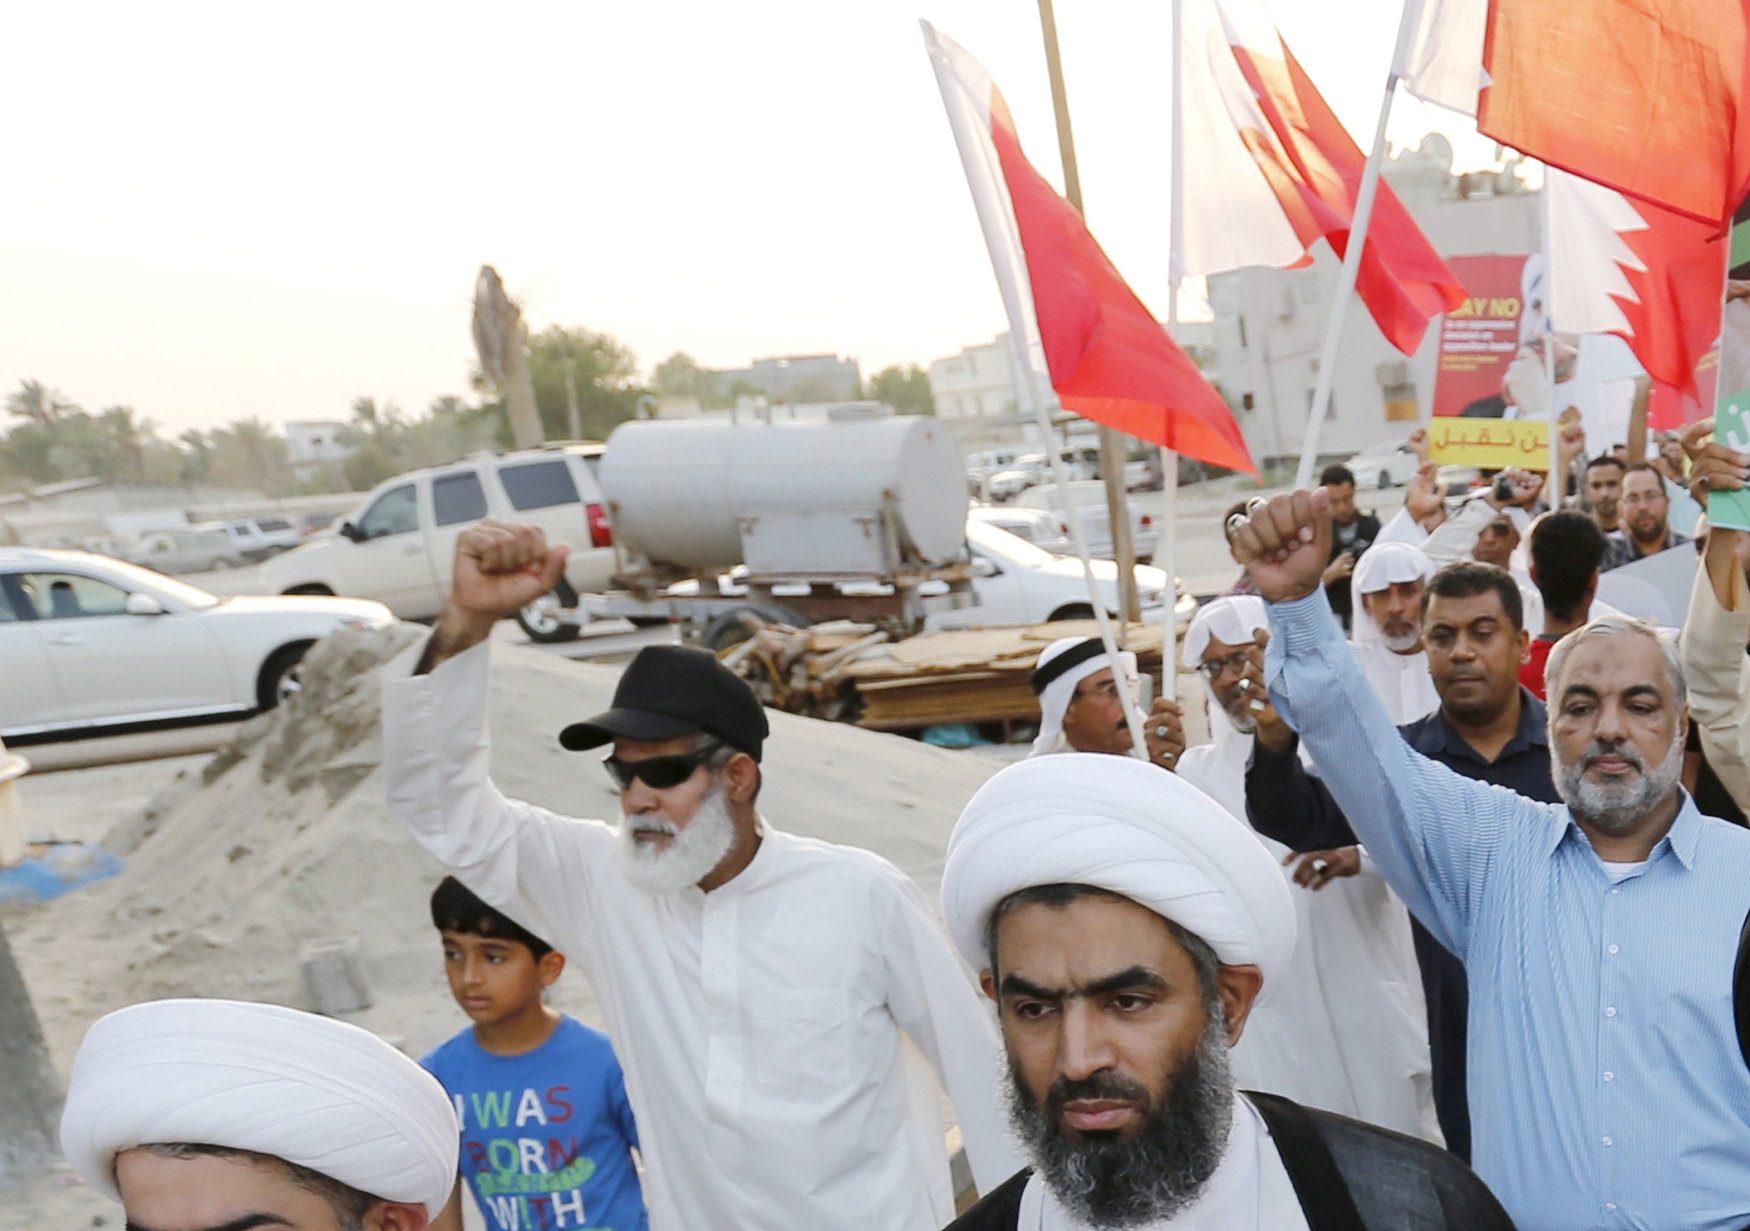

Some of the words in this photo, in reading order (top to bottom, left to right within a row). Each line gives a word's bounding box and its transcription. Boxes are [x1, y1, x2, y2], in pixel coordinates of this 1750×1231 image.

[1489, 297, 1521, 319] NO
[1520, 428, 1549, 453] ن
[454, 1093, 466, 1132] I
[471, 1085, 574, 1129] WAS
[465, 1136, 578, 1176] BORN
